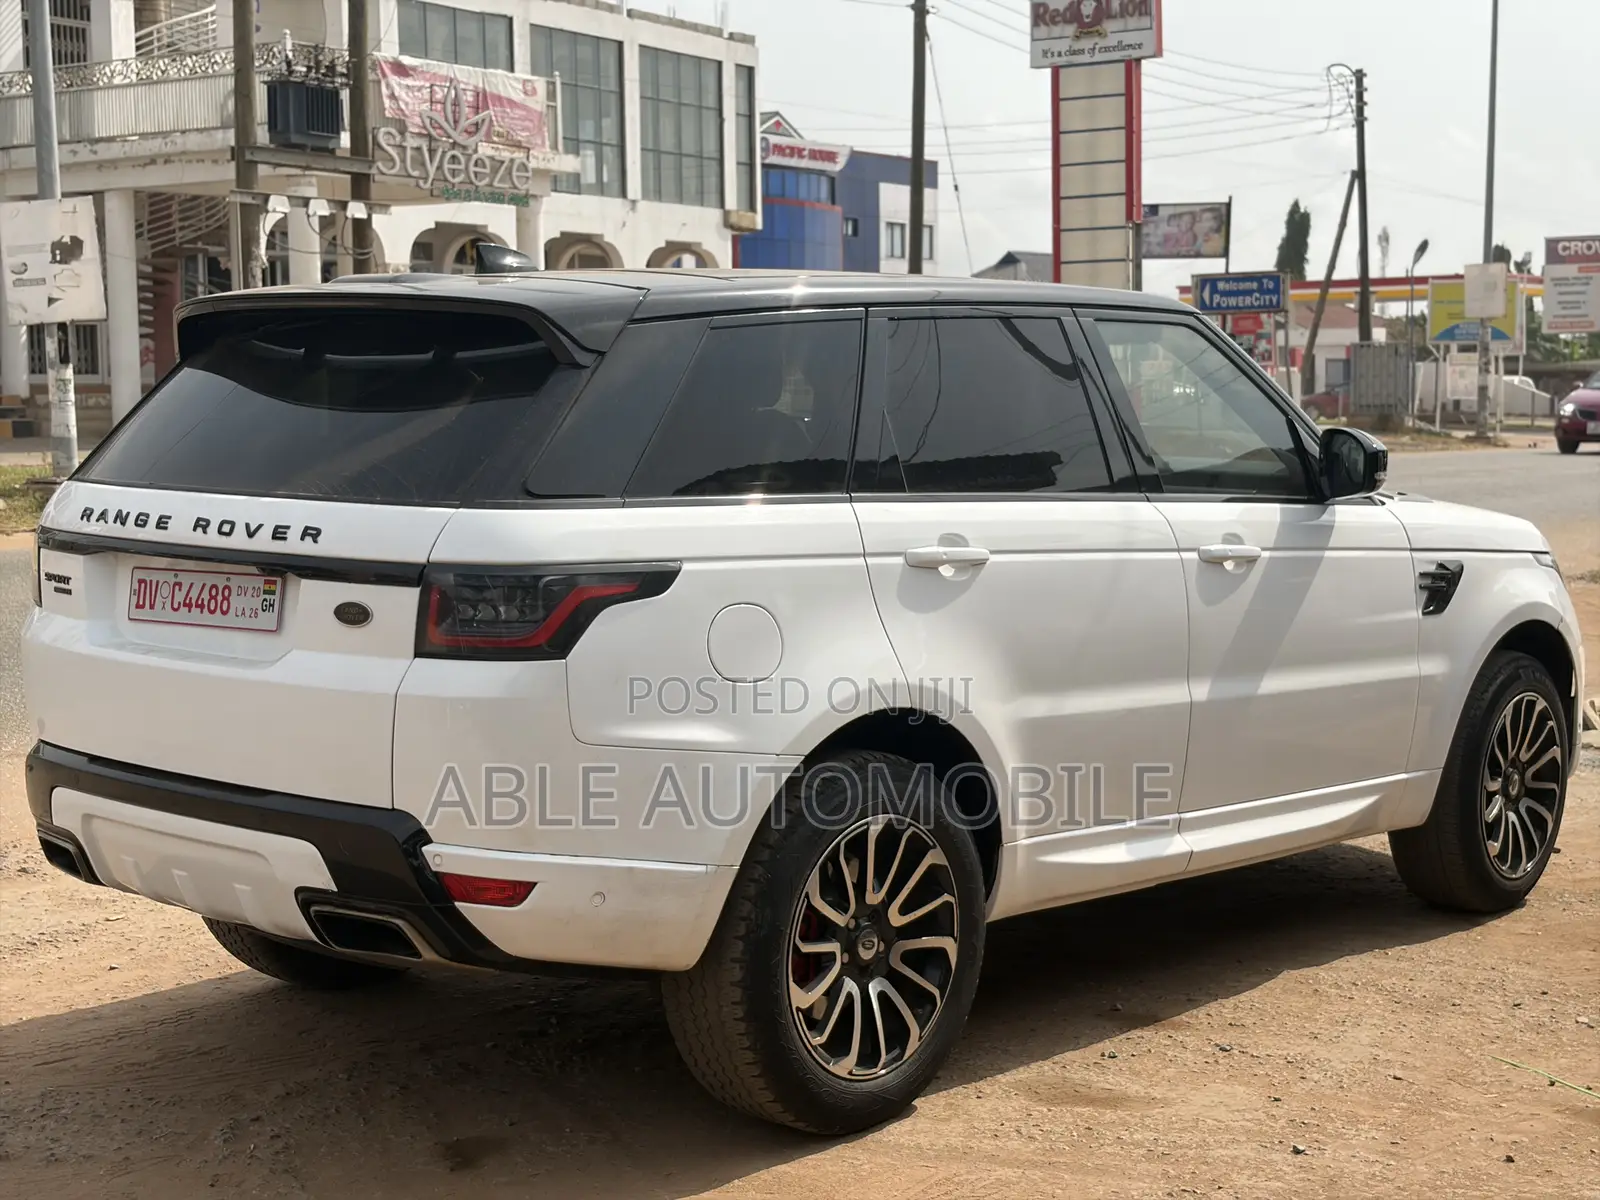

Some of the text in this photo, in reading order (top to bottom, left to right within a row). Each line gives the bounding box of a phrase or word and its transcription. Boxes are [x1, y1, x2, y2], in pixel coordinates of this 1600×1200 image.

[1032, 0, 1150, 27] Red Lion
[1042, 47, 1055, 59] It's
[1064, 45, 1086, 57] class
[1087, 42, 1099, 58] of
[1098, 40, 1144, 54] excellence
[374, 126, 533, 190] Styeeze
[1216, 278, 1274, 291] Welcome To
[79, 506, 324, 544] RANGE ROVER
[135, 578, 232, 616] DV C4488
[236, 585, 262, 598] DV 20
[161, 600, 166, 611] X
[235, 607, 259, 619] LA 26
[261, 597, 276, 613] GH
